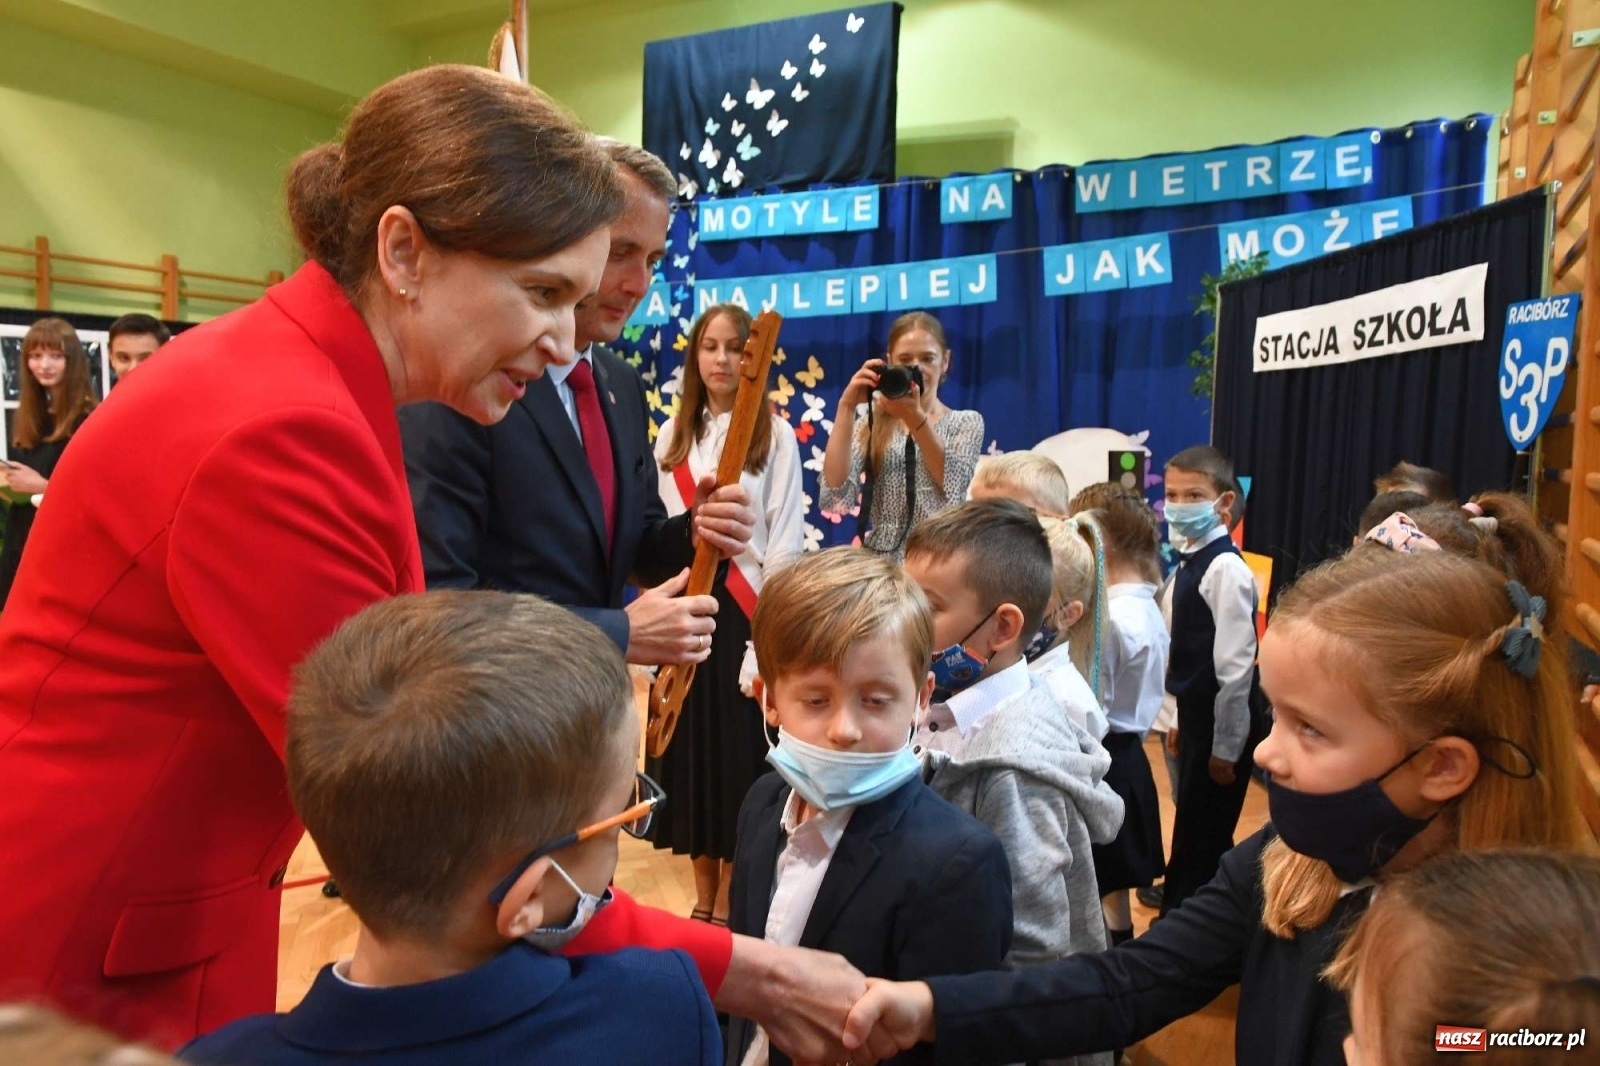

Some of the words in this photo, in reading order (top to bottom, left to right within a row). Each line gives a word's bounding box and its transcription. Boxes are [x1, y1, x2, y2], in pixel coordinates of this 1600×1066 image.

[704, 195, 872, 232] MOTYLE
[948, 184, 1006, 213] NA
[1077, 144, 1373, 203] WIETRZE,
[646, 291, 666, 317] A
[699, 263, 988, 314] NAJLEPIEJ
[1055, 243, 1165, 285] JAK
[1508, 297, 1571, 325] RACIBÓRZ
[1258, 325, 1341, 364] STACJA
[1352, 296, 1471, 351] SZKOŁA
